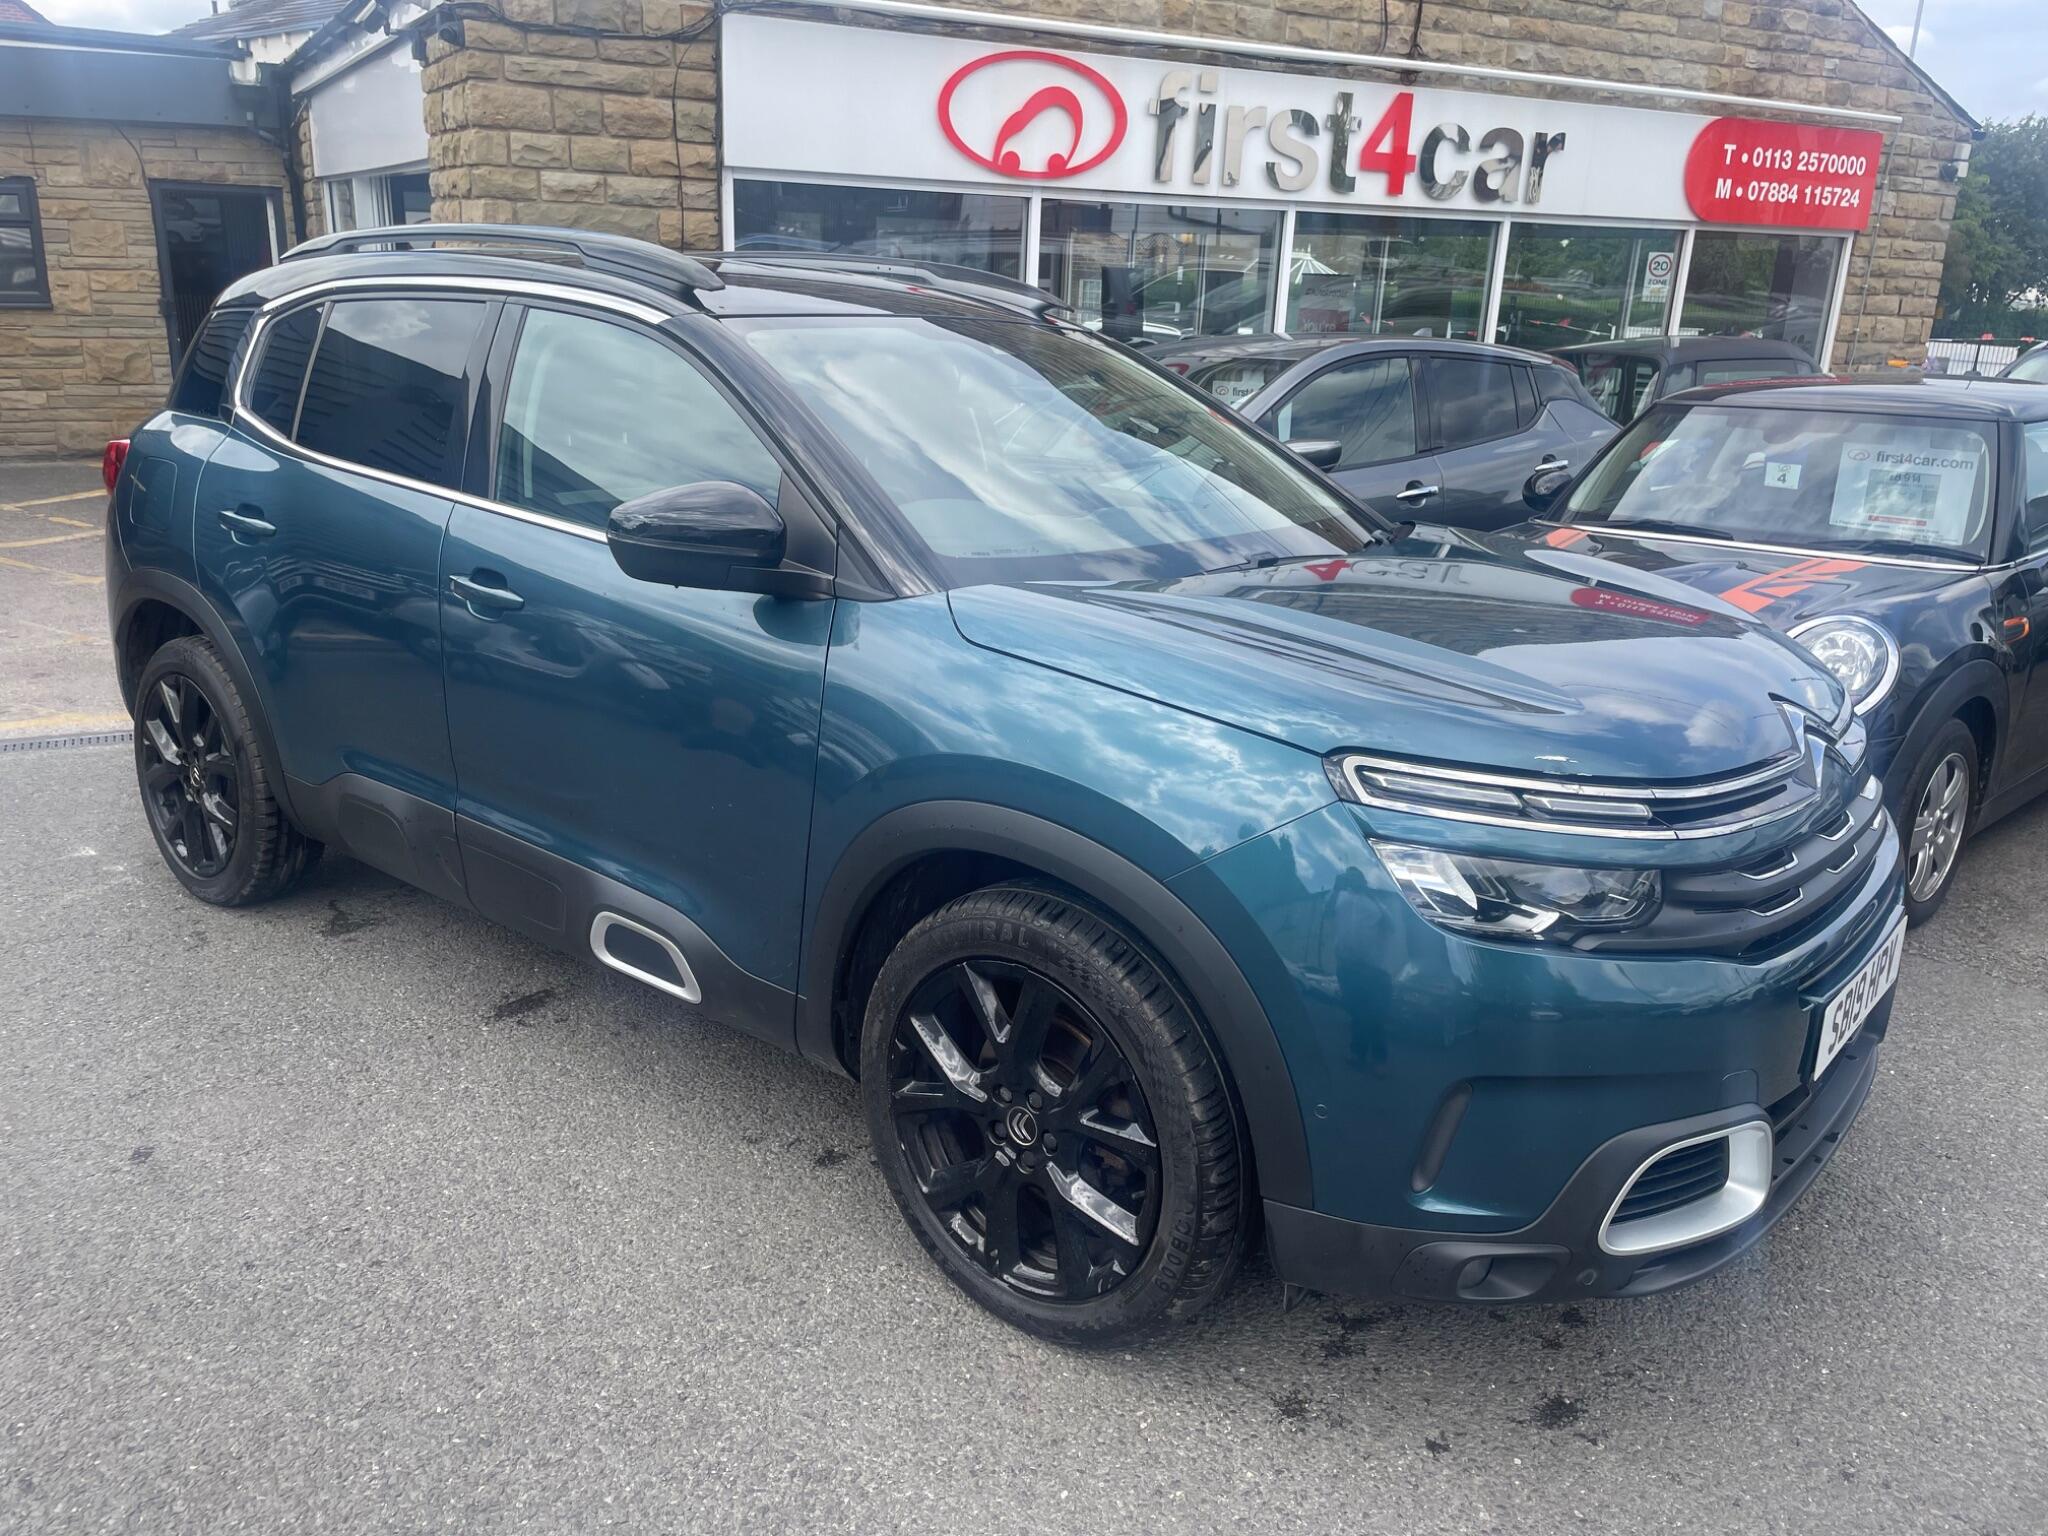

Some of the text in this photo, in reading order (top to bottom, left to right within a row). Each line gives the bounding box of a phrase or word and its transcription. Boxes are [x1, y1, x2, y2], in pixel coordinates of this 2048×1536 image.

[1149, 70, 1567, 204] first4car
[1724, 144, 1867, 176] T 0113 2570000
[1715, 178, 1860, 208] M 07884 115724
[1652, 260, 1669, 271] 20
[1876, 451, 1974, 470] first4car.com
[1828, 934, 1899, 1055] SB19 HPV
